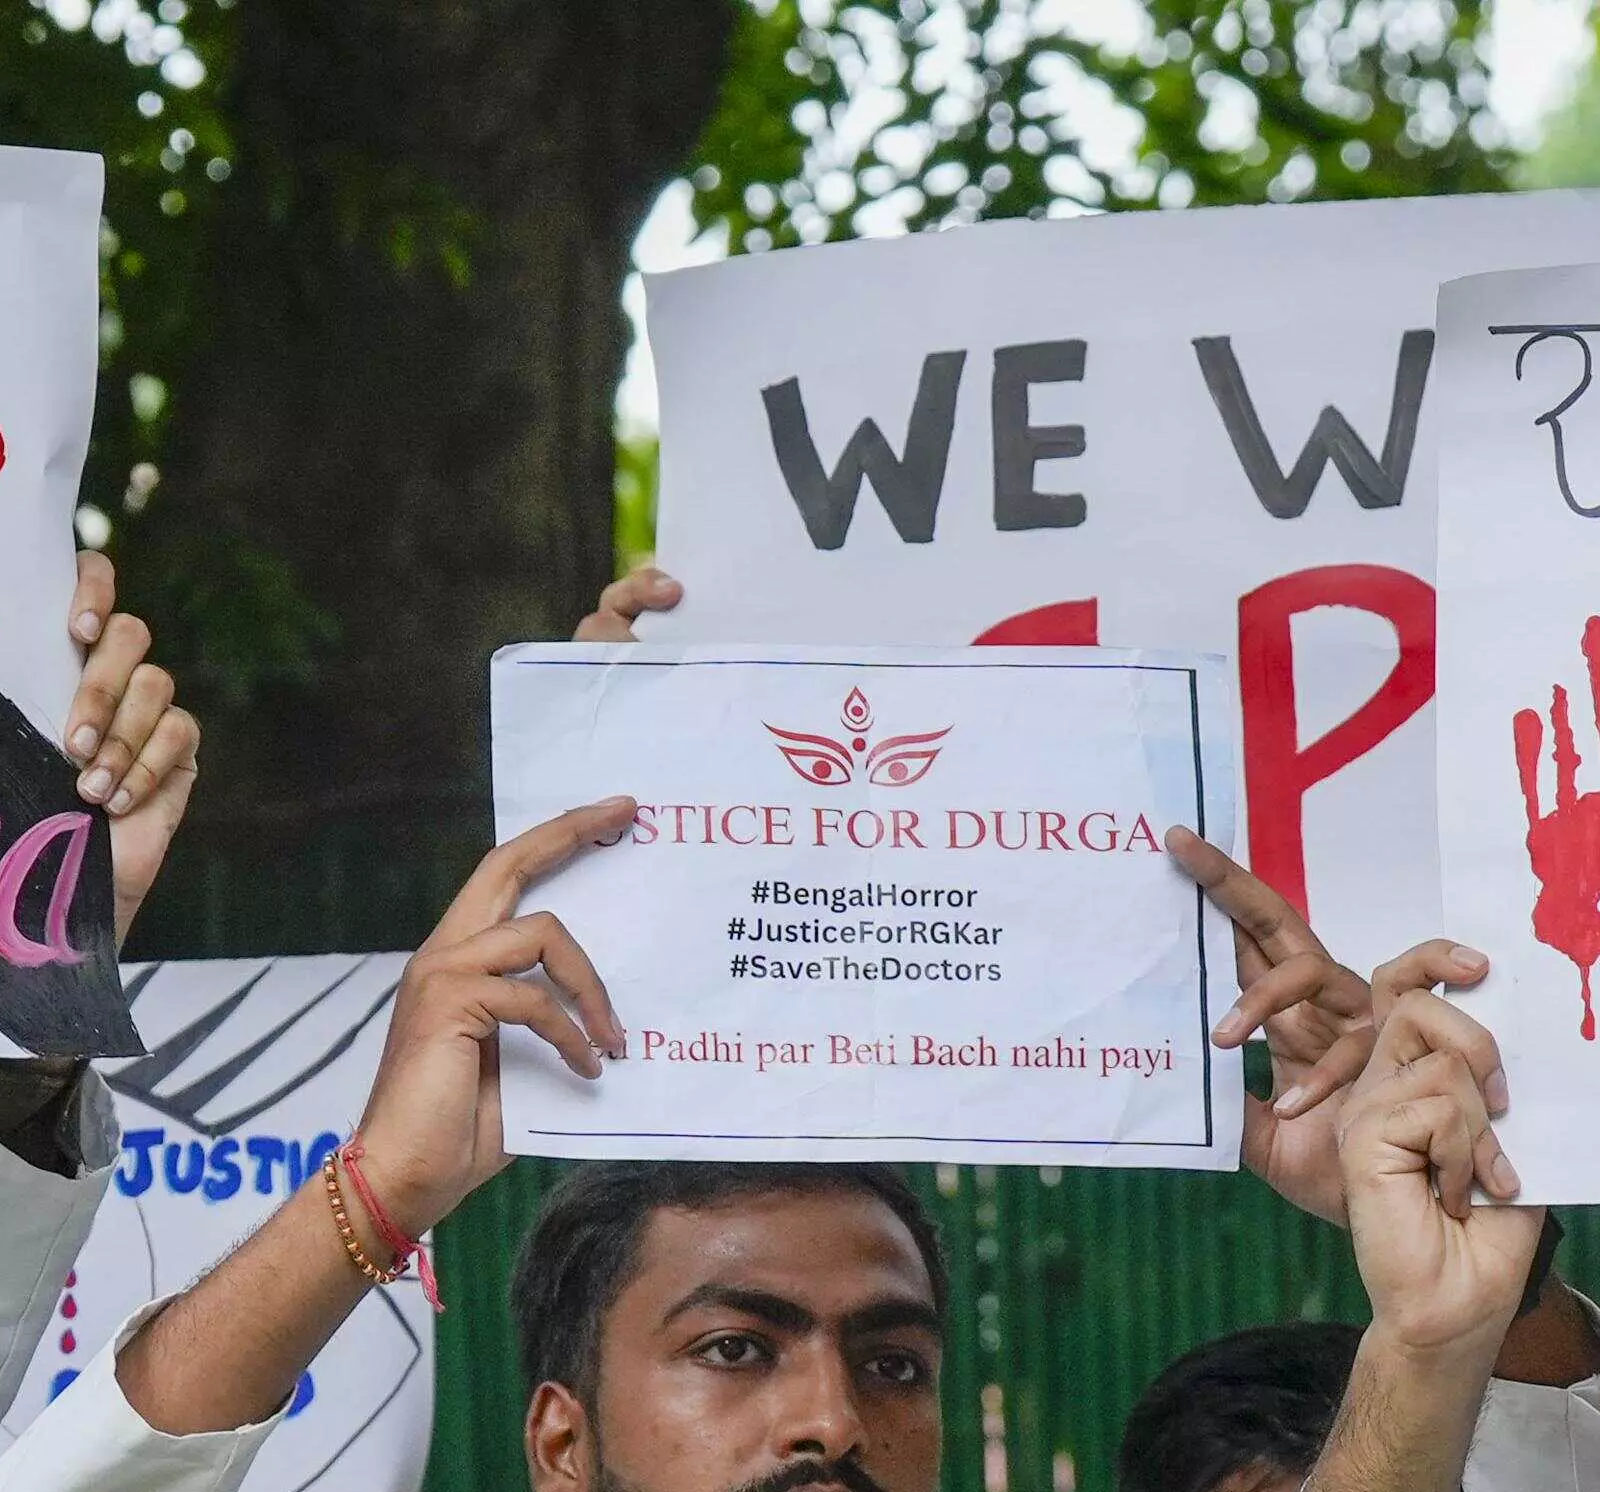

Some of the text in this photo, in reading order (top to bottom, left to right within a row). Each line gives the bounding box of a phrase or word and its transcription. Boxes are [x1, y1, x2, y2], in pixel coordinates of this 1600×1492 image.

[761, 340, 1087, 551] WE
[811, 808, 929, 848] FOR
[945, 811, 1164, 853] DURGA
[751, 880, 978, 914] #BengalHorror
[727, 917, 1003, 946] #JusticeForRGKar
[730, 954, 1002, 982] #SaveTheDoctors
[641, 1030, 744, 1063] Padhi
[755, 1042, 815, 1072] par
[827, 1034, 899, 1065] Beti
[910, 1034, 1000, 1067] Bach
[1010, 1036, 1088, 1069] nahi
[1100, 1040, 1173, 1078] payi
